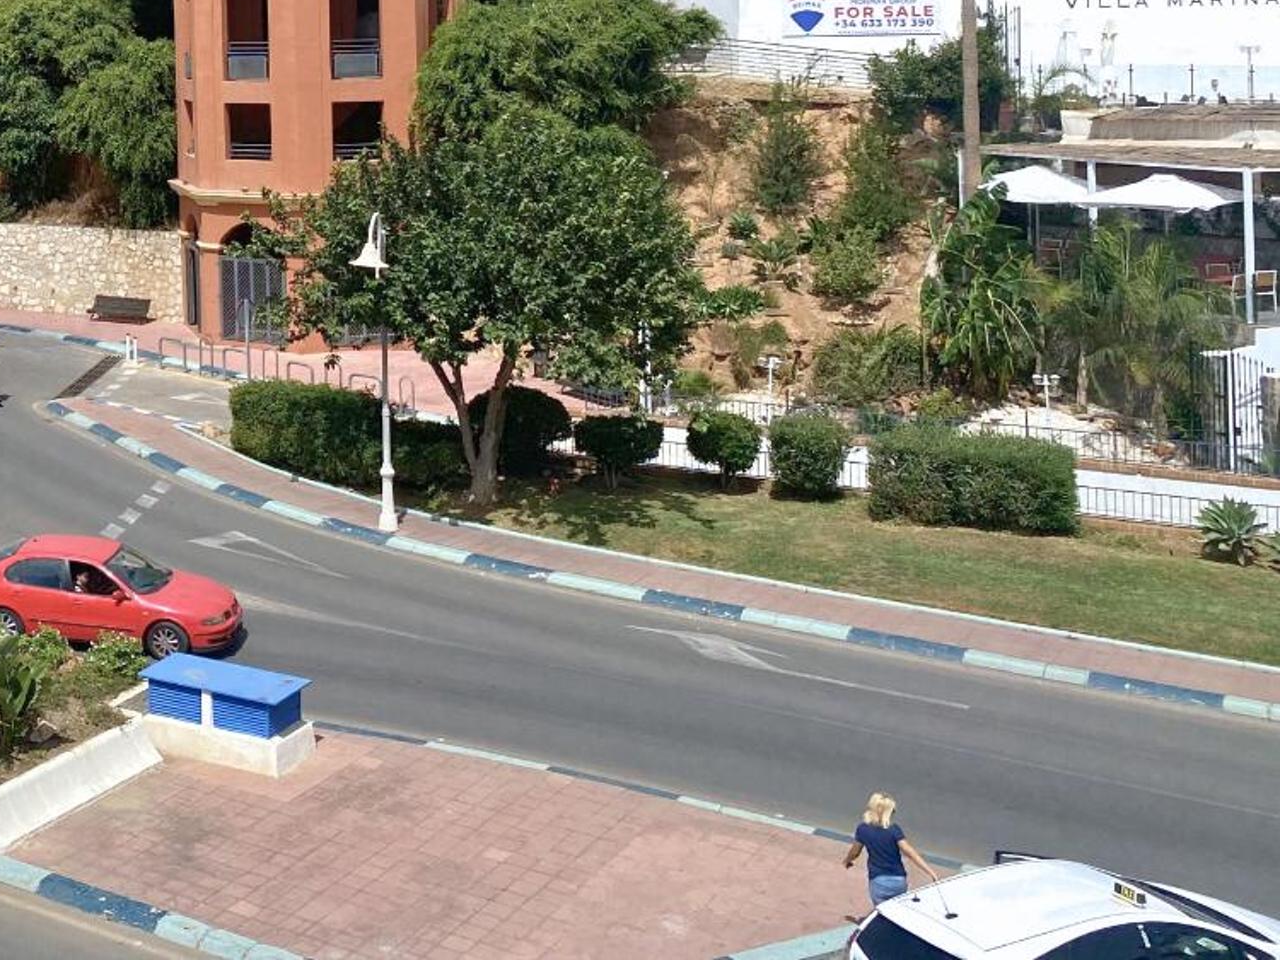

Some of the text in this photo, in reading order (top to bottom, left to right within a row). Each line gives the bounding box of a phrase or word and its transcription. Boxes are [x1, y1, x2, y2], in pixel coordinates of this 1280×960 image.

[834, 5, 934, 18] FOR SALE
[835, 18, 934, 28] +34 633 173 390
